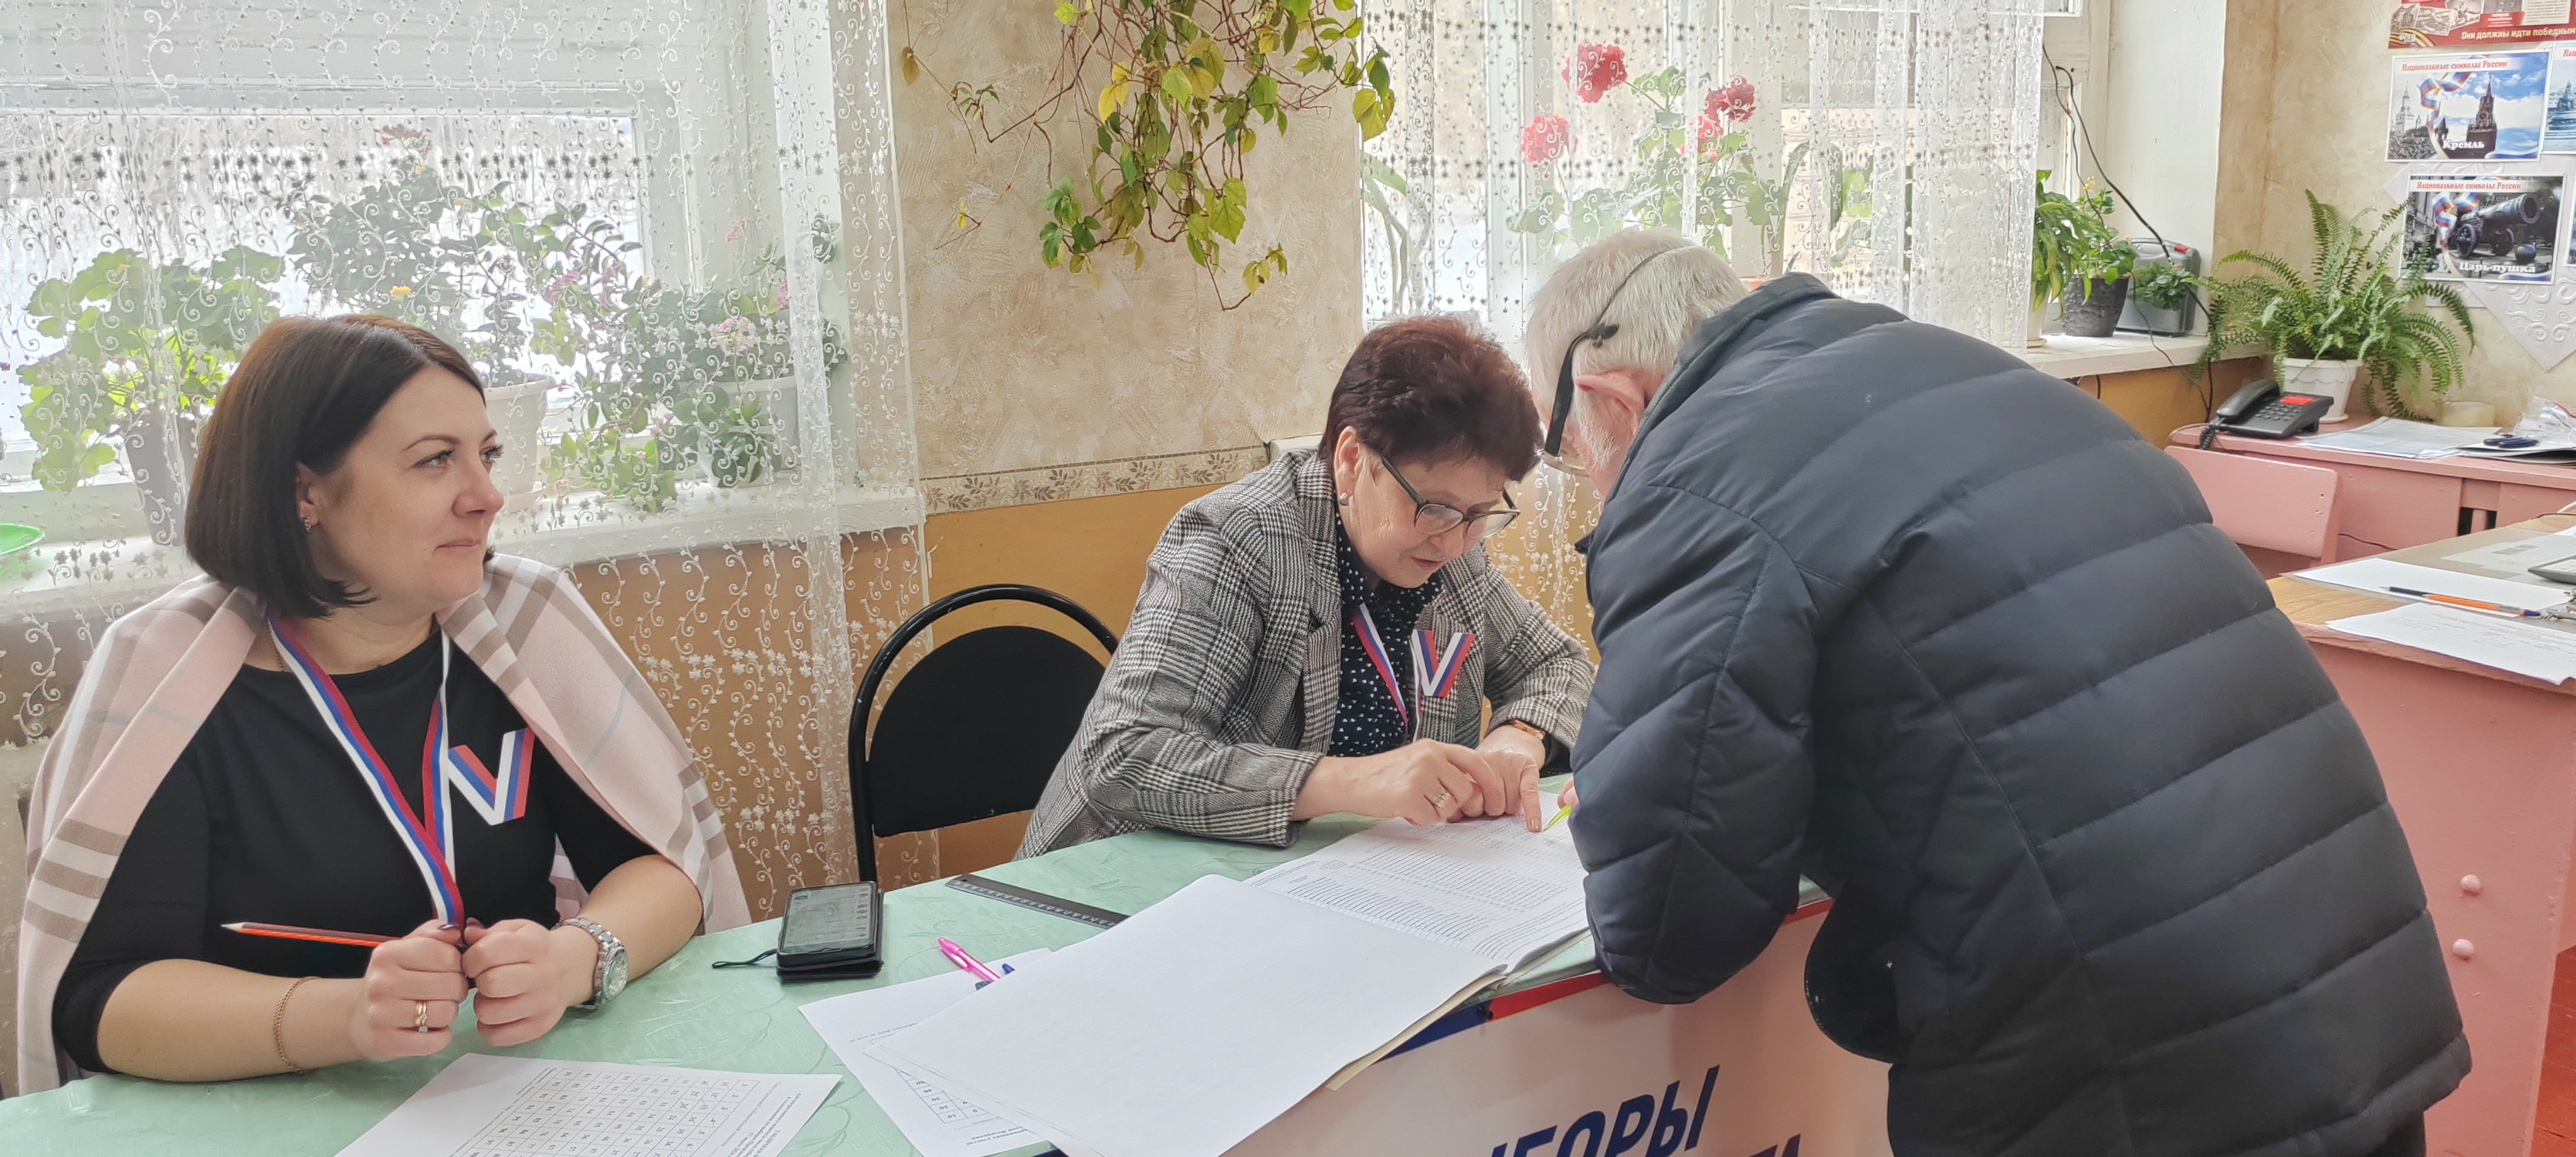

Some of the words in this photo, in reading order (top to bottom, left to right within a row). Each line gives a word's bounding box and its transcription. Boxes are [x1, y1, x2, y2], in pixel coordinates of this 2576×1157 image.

[2462, 31, 2475, 40] Они
[2477, 30, 2509, 40] должны
[2511, 30, 2531, 38] идти
[2402, 64, 2448, 72] Национальные
[2443, 140, 2485, 150] Кремль
[2416, 181, 2463, 190] Национальные
[2458, 262, 2536, 274] Царь-пушка
